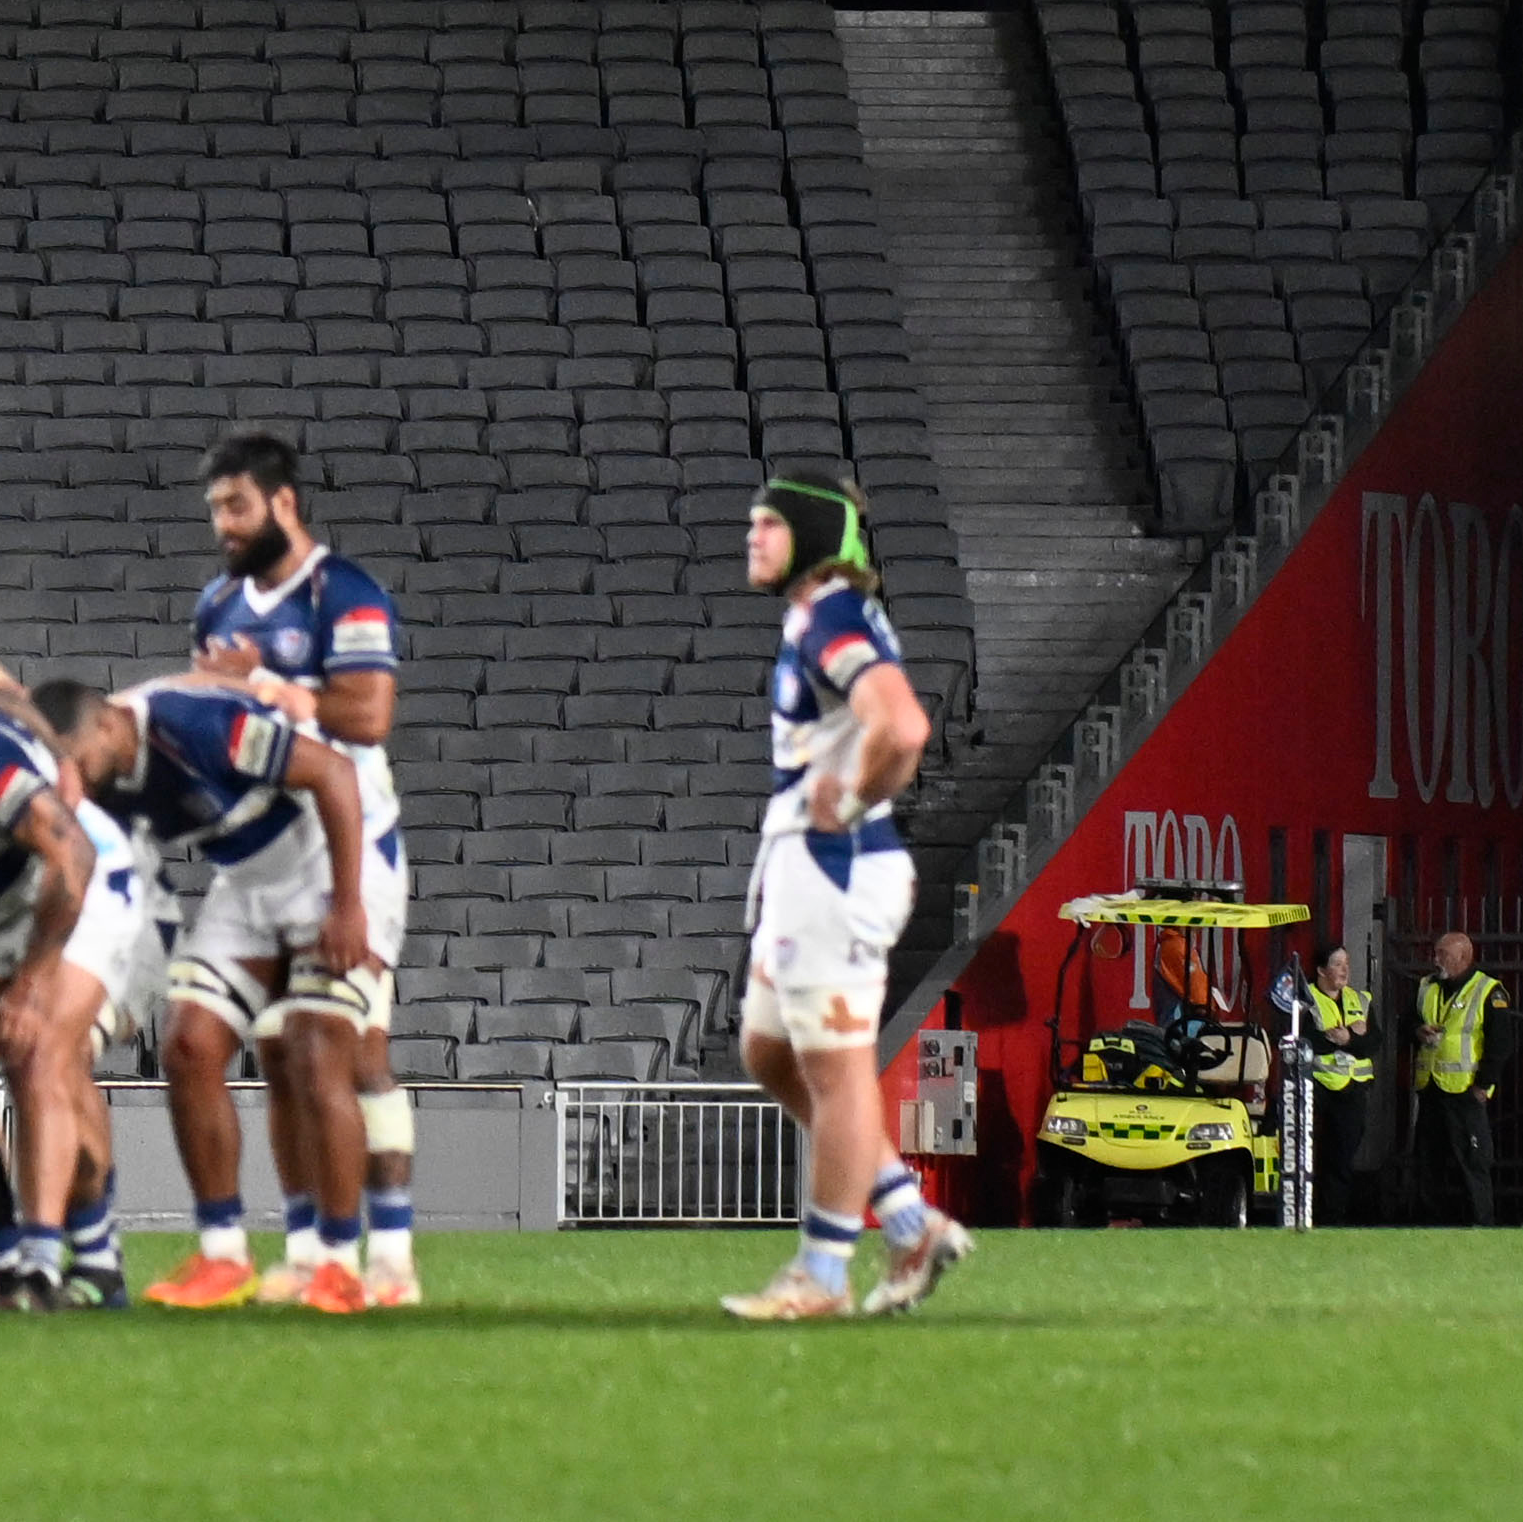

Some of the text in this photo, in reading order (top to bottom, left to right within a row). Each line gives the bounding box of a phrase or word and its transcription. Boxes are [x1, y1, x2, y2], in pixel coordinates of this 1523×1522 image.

[1283, 1078, 1297, 1227] AUCKLAND RUGB
[1304, 1180, 1314, 1229] RUGB
